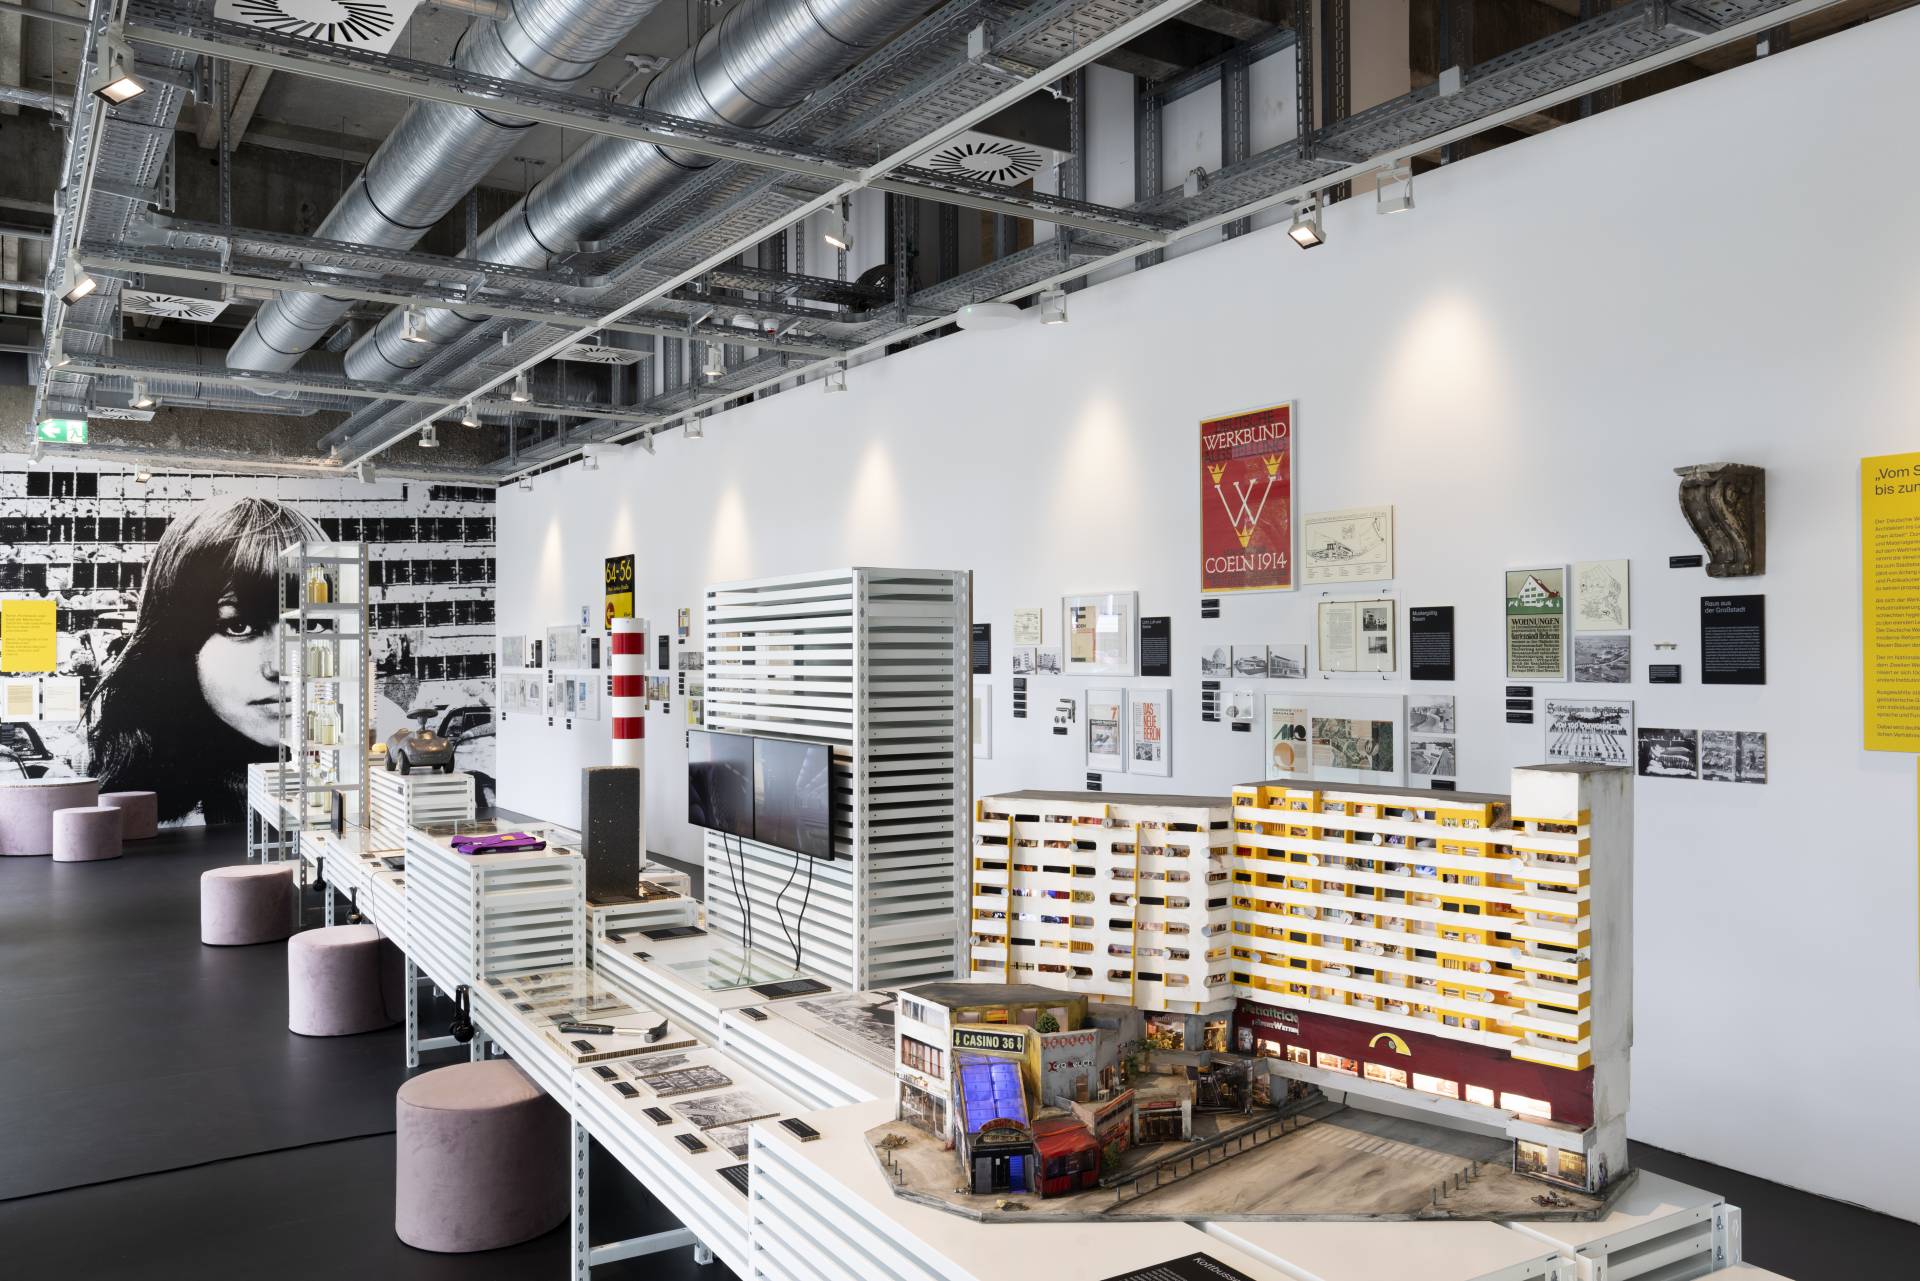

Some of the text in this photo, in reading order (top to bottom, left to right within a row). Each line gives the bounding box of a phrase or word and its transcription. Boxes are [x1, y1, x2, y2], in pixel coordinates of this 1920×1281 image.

[1202, 422, 1287, 451] WERKBUND
[1875, 483, 1895, 496] bis
[606, 559, 632, 583] 64-56
[1205, 554, 1255, 574] COELN
[1257, 551, 1287, 570] 1914
[963, 1033, 1014, 1049] CASINO 36
